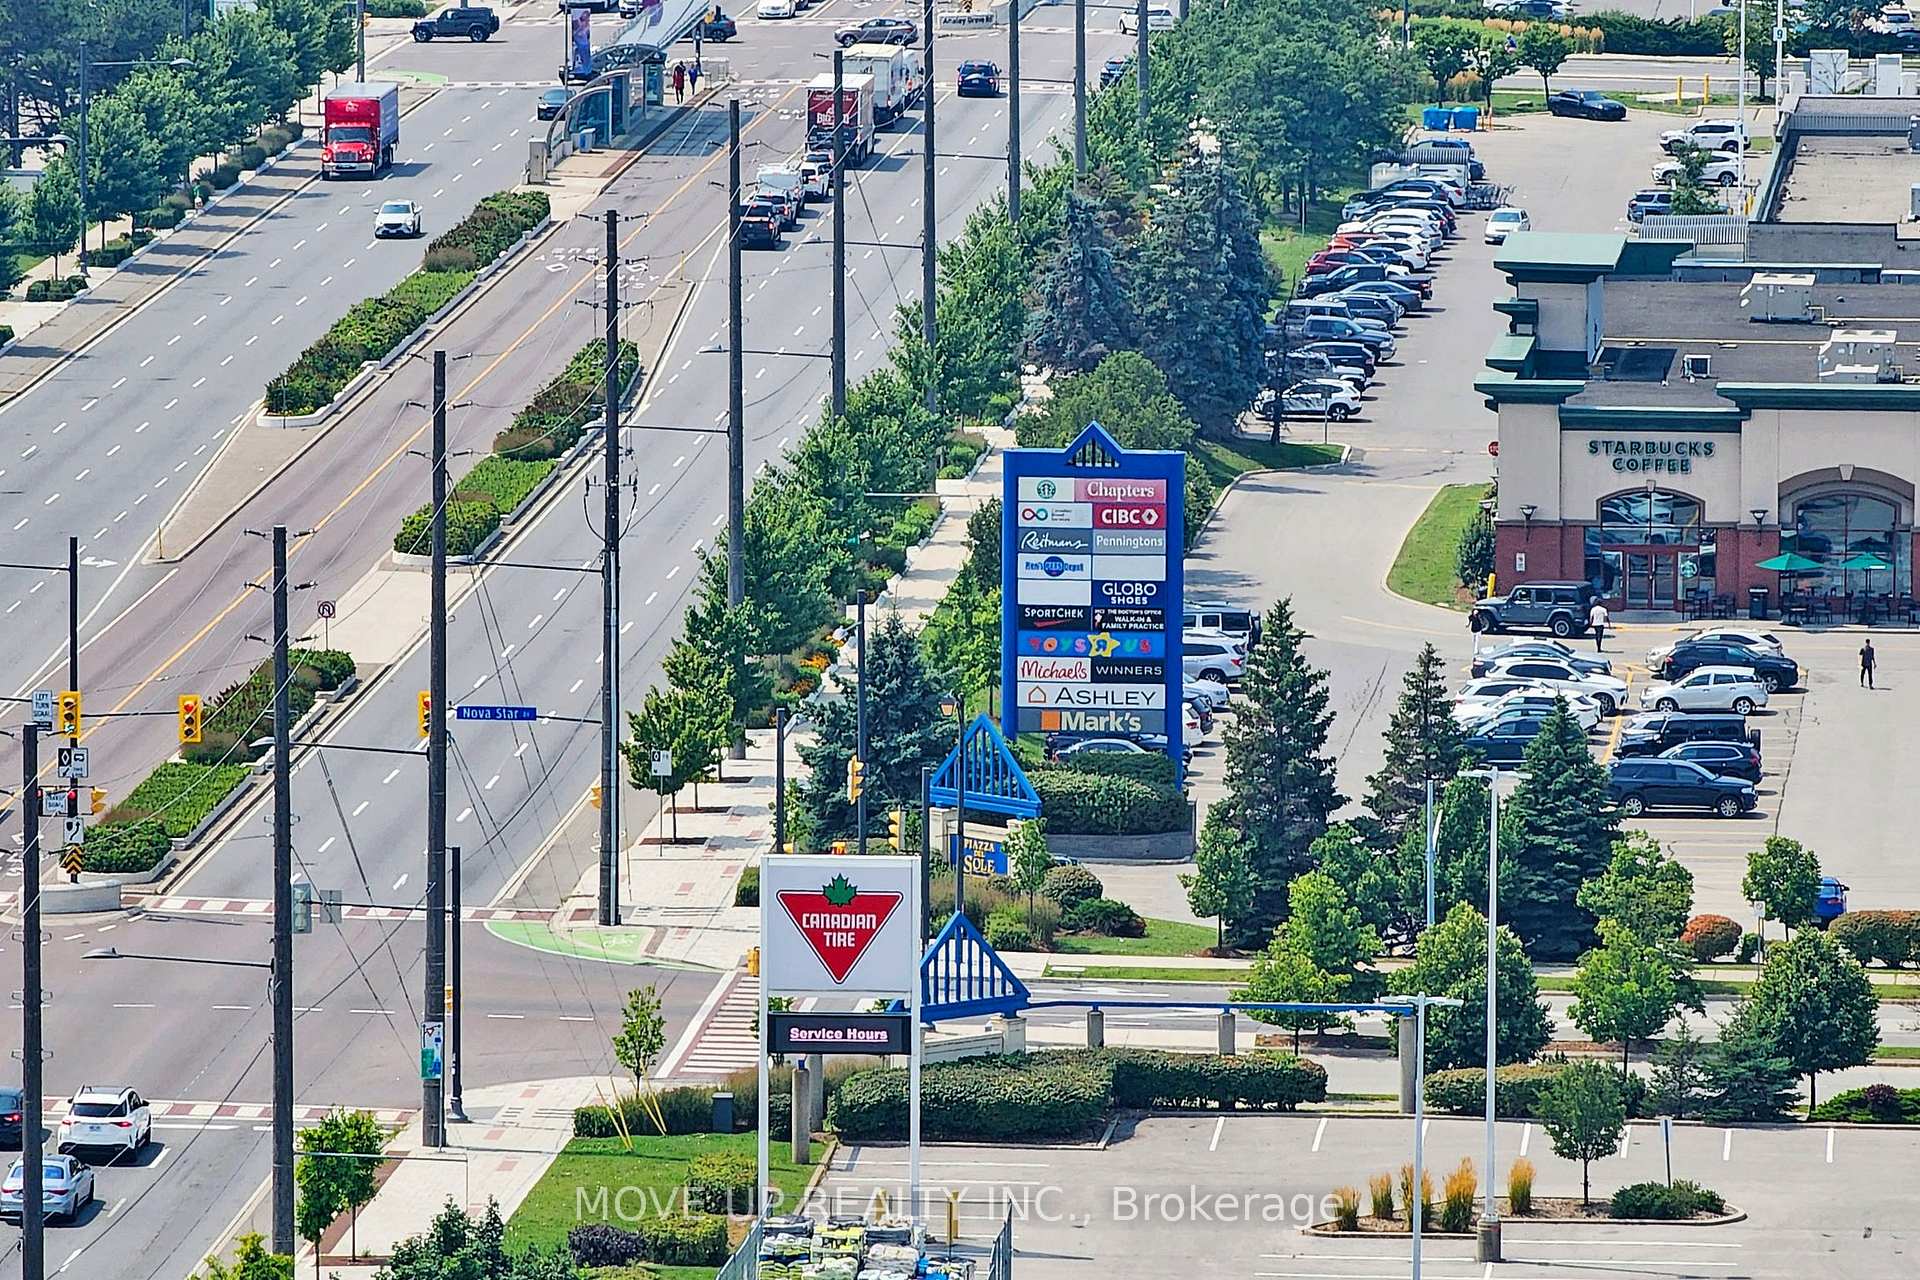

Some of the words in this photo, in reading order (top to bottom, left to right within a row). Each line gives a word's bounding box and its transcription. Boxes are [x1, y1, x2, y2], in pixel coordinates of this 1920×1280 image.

[1776, 28, 1784, 40] 9
[1587, 440, 1716, 456] STARBUCKS
[1611, 457, 1692, 474] COFFEE
[1087, 481, 1155, 502] Chapters
[1101, 509, 1140, 524] CIBC
[1021, 531, 1089, 549] Reitmans
[1096, 535, 1163, 548] Penningtons
[1102, 583, 1157, 595] GLOBO
[1110, 597, 1148, 605] SHOES
[1095, 665, 1162, 676] WINNERS
[1055, 687, 1156, 705] ASHLEY
[463, 708, 491, 719] Nova
[495, 708, 519, 719] Star
[1061, 711, 1141, 732] Mark's
[963, 839, 995, 853] PIAZZA
[963, 855, 996, 874] SOLE
[802, 913, 877, 929] CANADIAN
[823, 932, 856, 947] TIRE
[789, 1028, 843, 1039] Service
[846, 1028, 888, 1040] Hours
